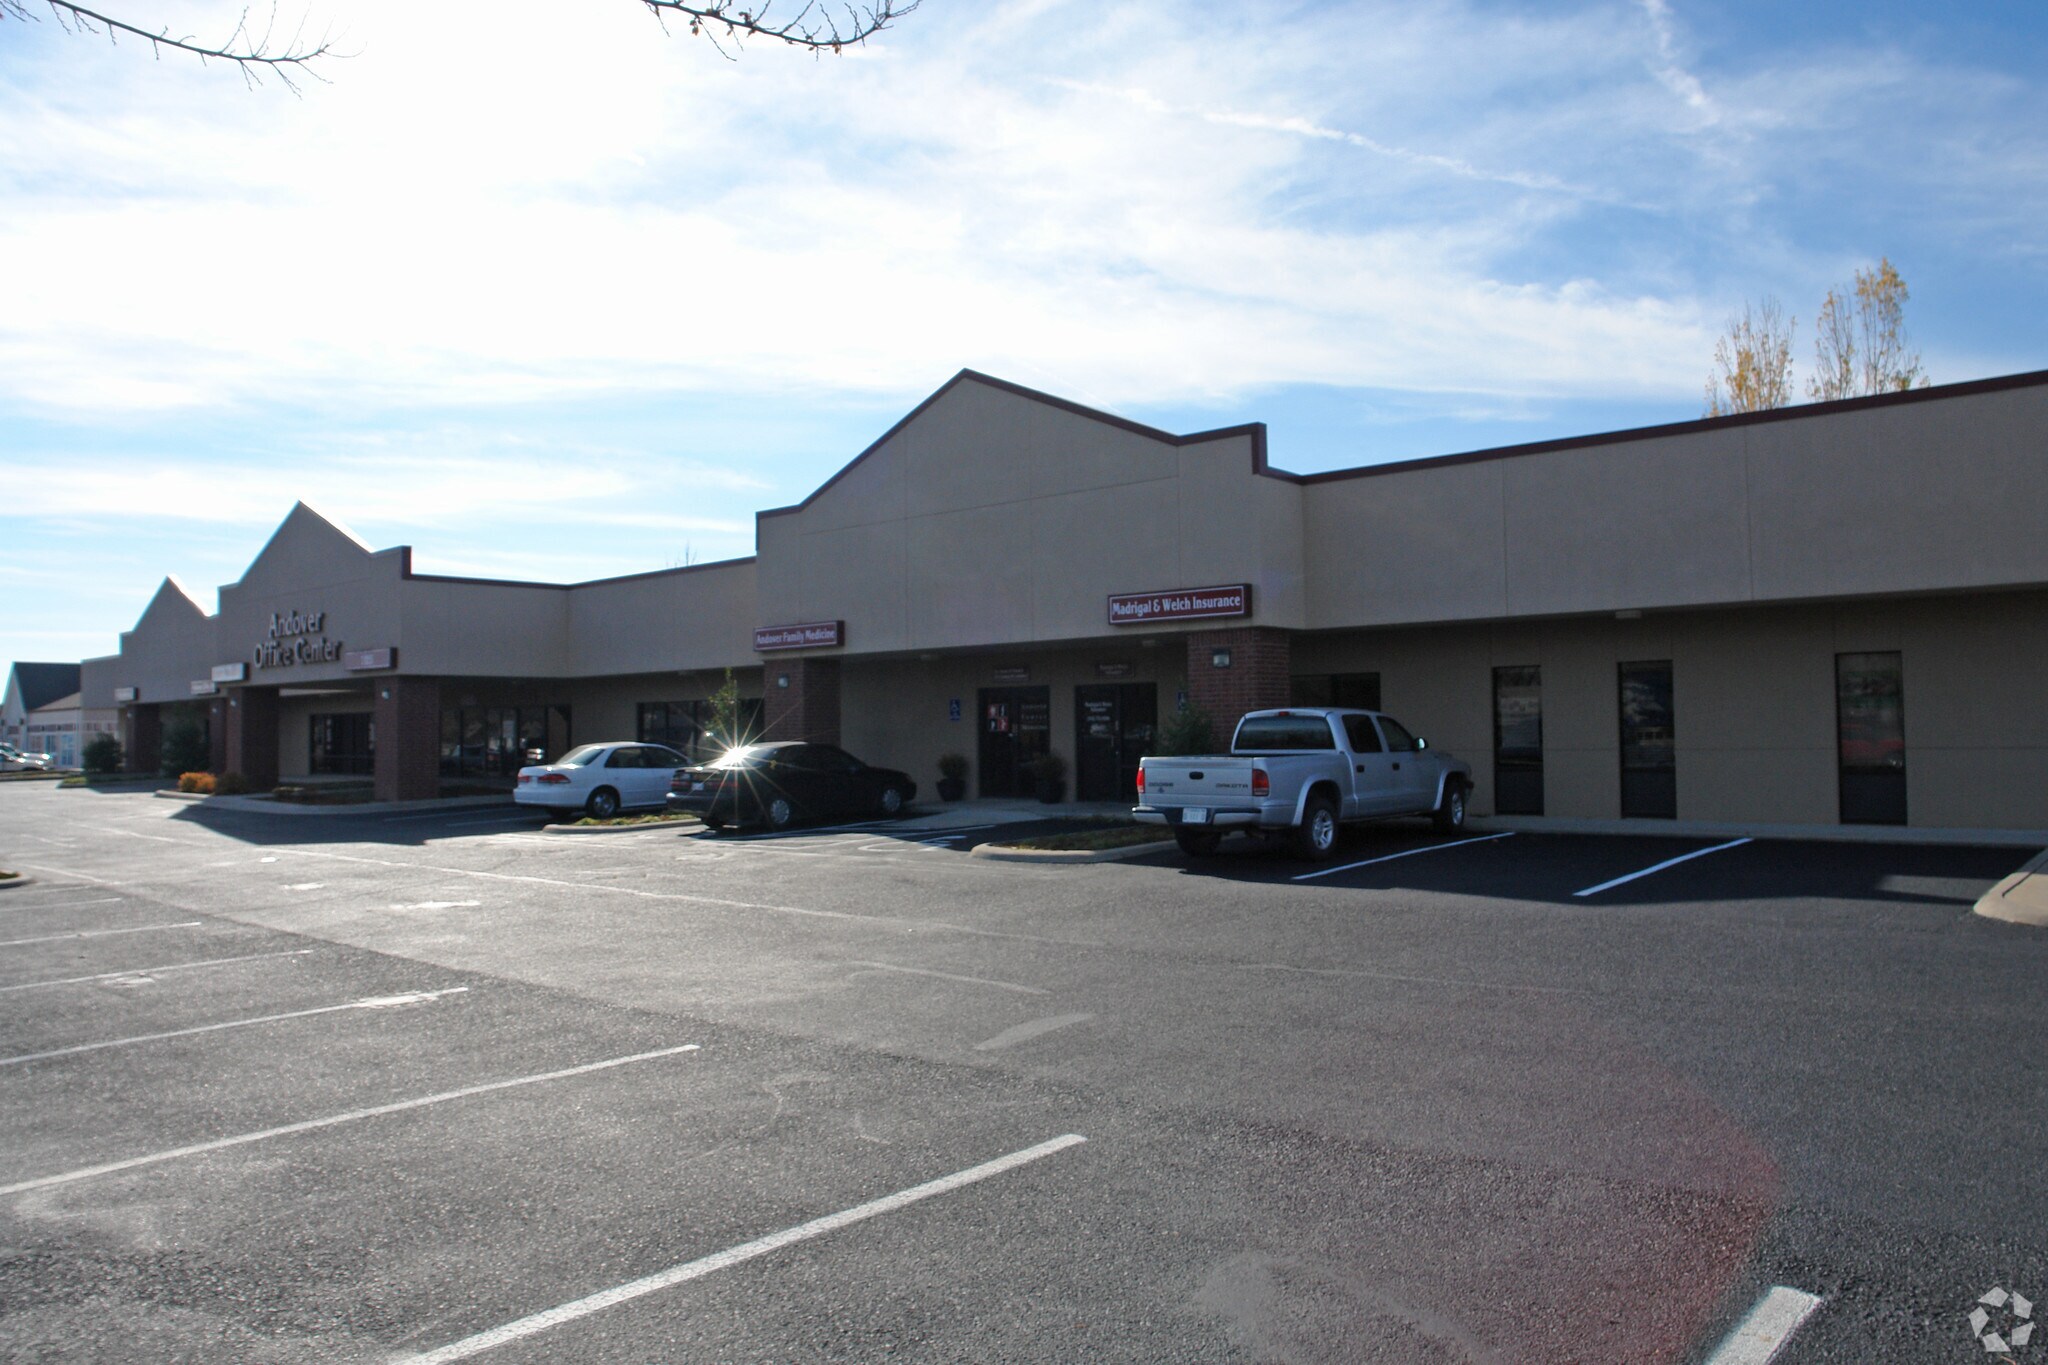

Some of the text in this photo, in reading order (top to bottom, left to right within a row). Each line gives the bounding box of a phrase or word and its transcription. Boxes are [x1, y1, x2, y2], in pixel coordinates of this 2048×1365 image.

[1113, 595, 1241, 617] Madrigal & Welch Insurance
[268, 611, 324, 638] Andover
[783, 631, 804, 644] Family
[805, 629, 835, 640] Medicine
[254, 642, 293, 669] Office
[294, 638, 341, 664] Center
